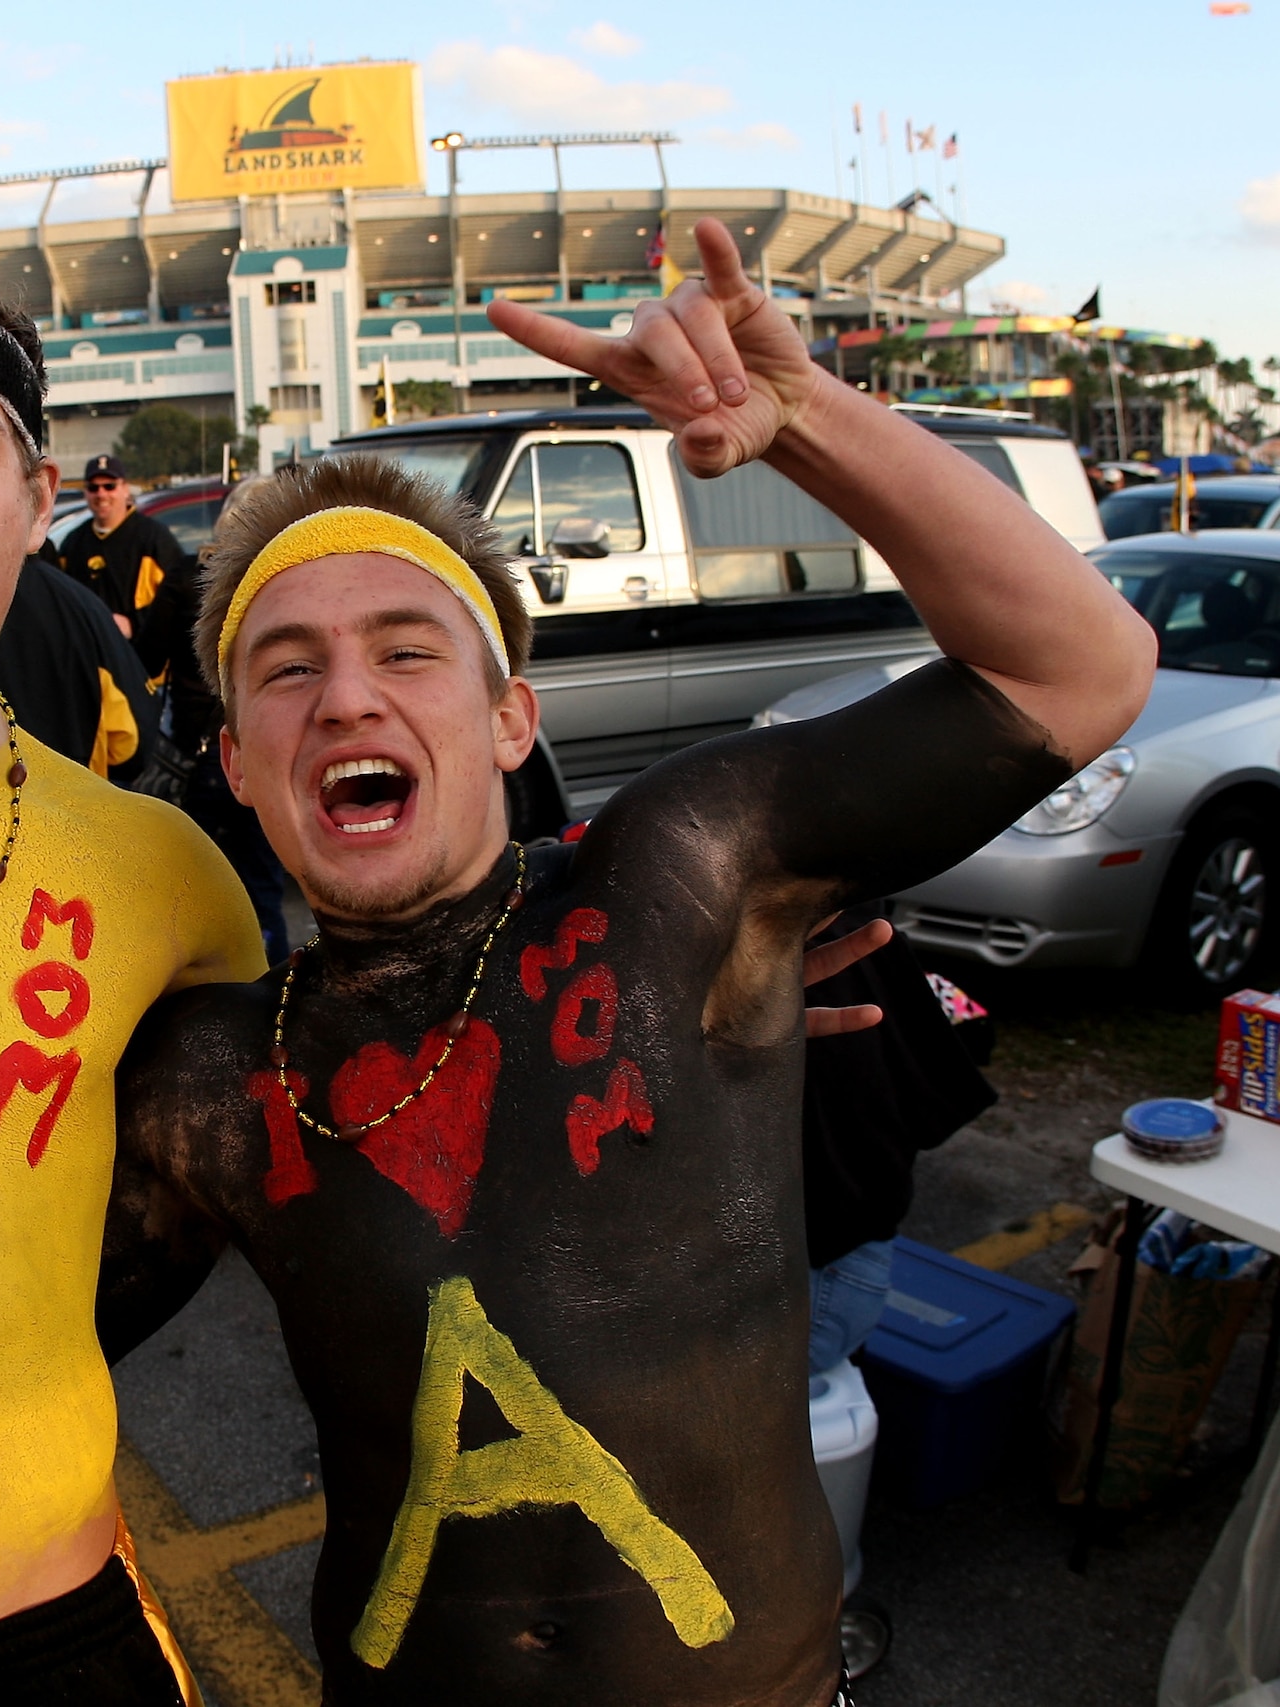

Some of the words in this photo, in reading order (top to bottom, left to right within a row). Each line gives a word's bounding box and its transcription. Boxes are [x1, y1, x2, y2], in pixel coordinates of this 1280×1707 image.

[224, 149, 363, 173] LANDSHARK
[245, 1070, 318, 1206] I
[520, 907, 656, 1178] MOM
[351, 1275, 735, 1670] A
